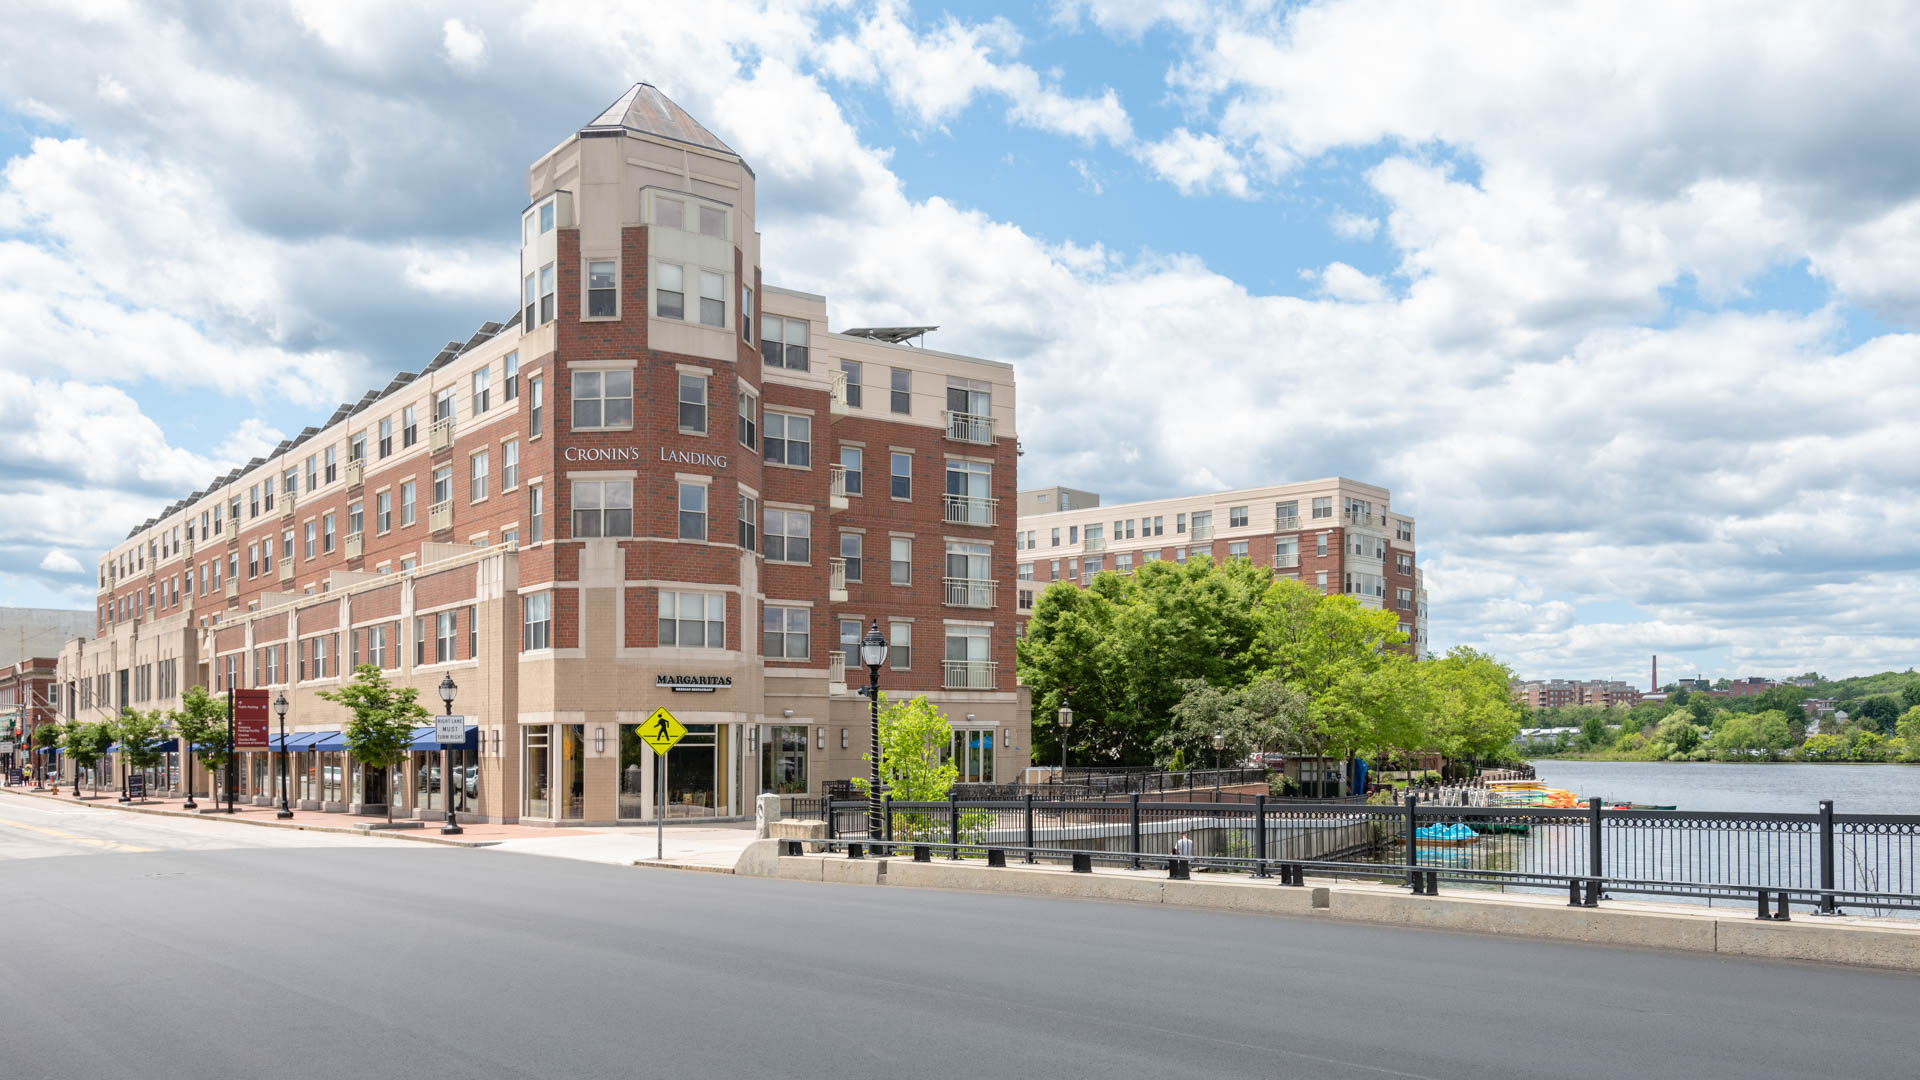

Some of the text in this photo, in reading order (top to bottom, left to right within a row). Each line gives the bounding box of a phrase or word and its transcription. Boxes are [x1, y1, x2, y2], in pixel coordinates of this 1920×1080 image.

[564, 446, 727, 468] CRONIN'S LANDING
[657, 675, 732, 685] MARGARITAS
